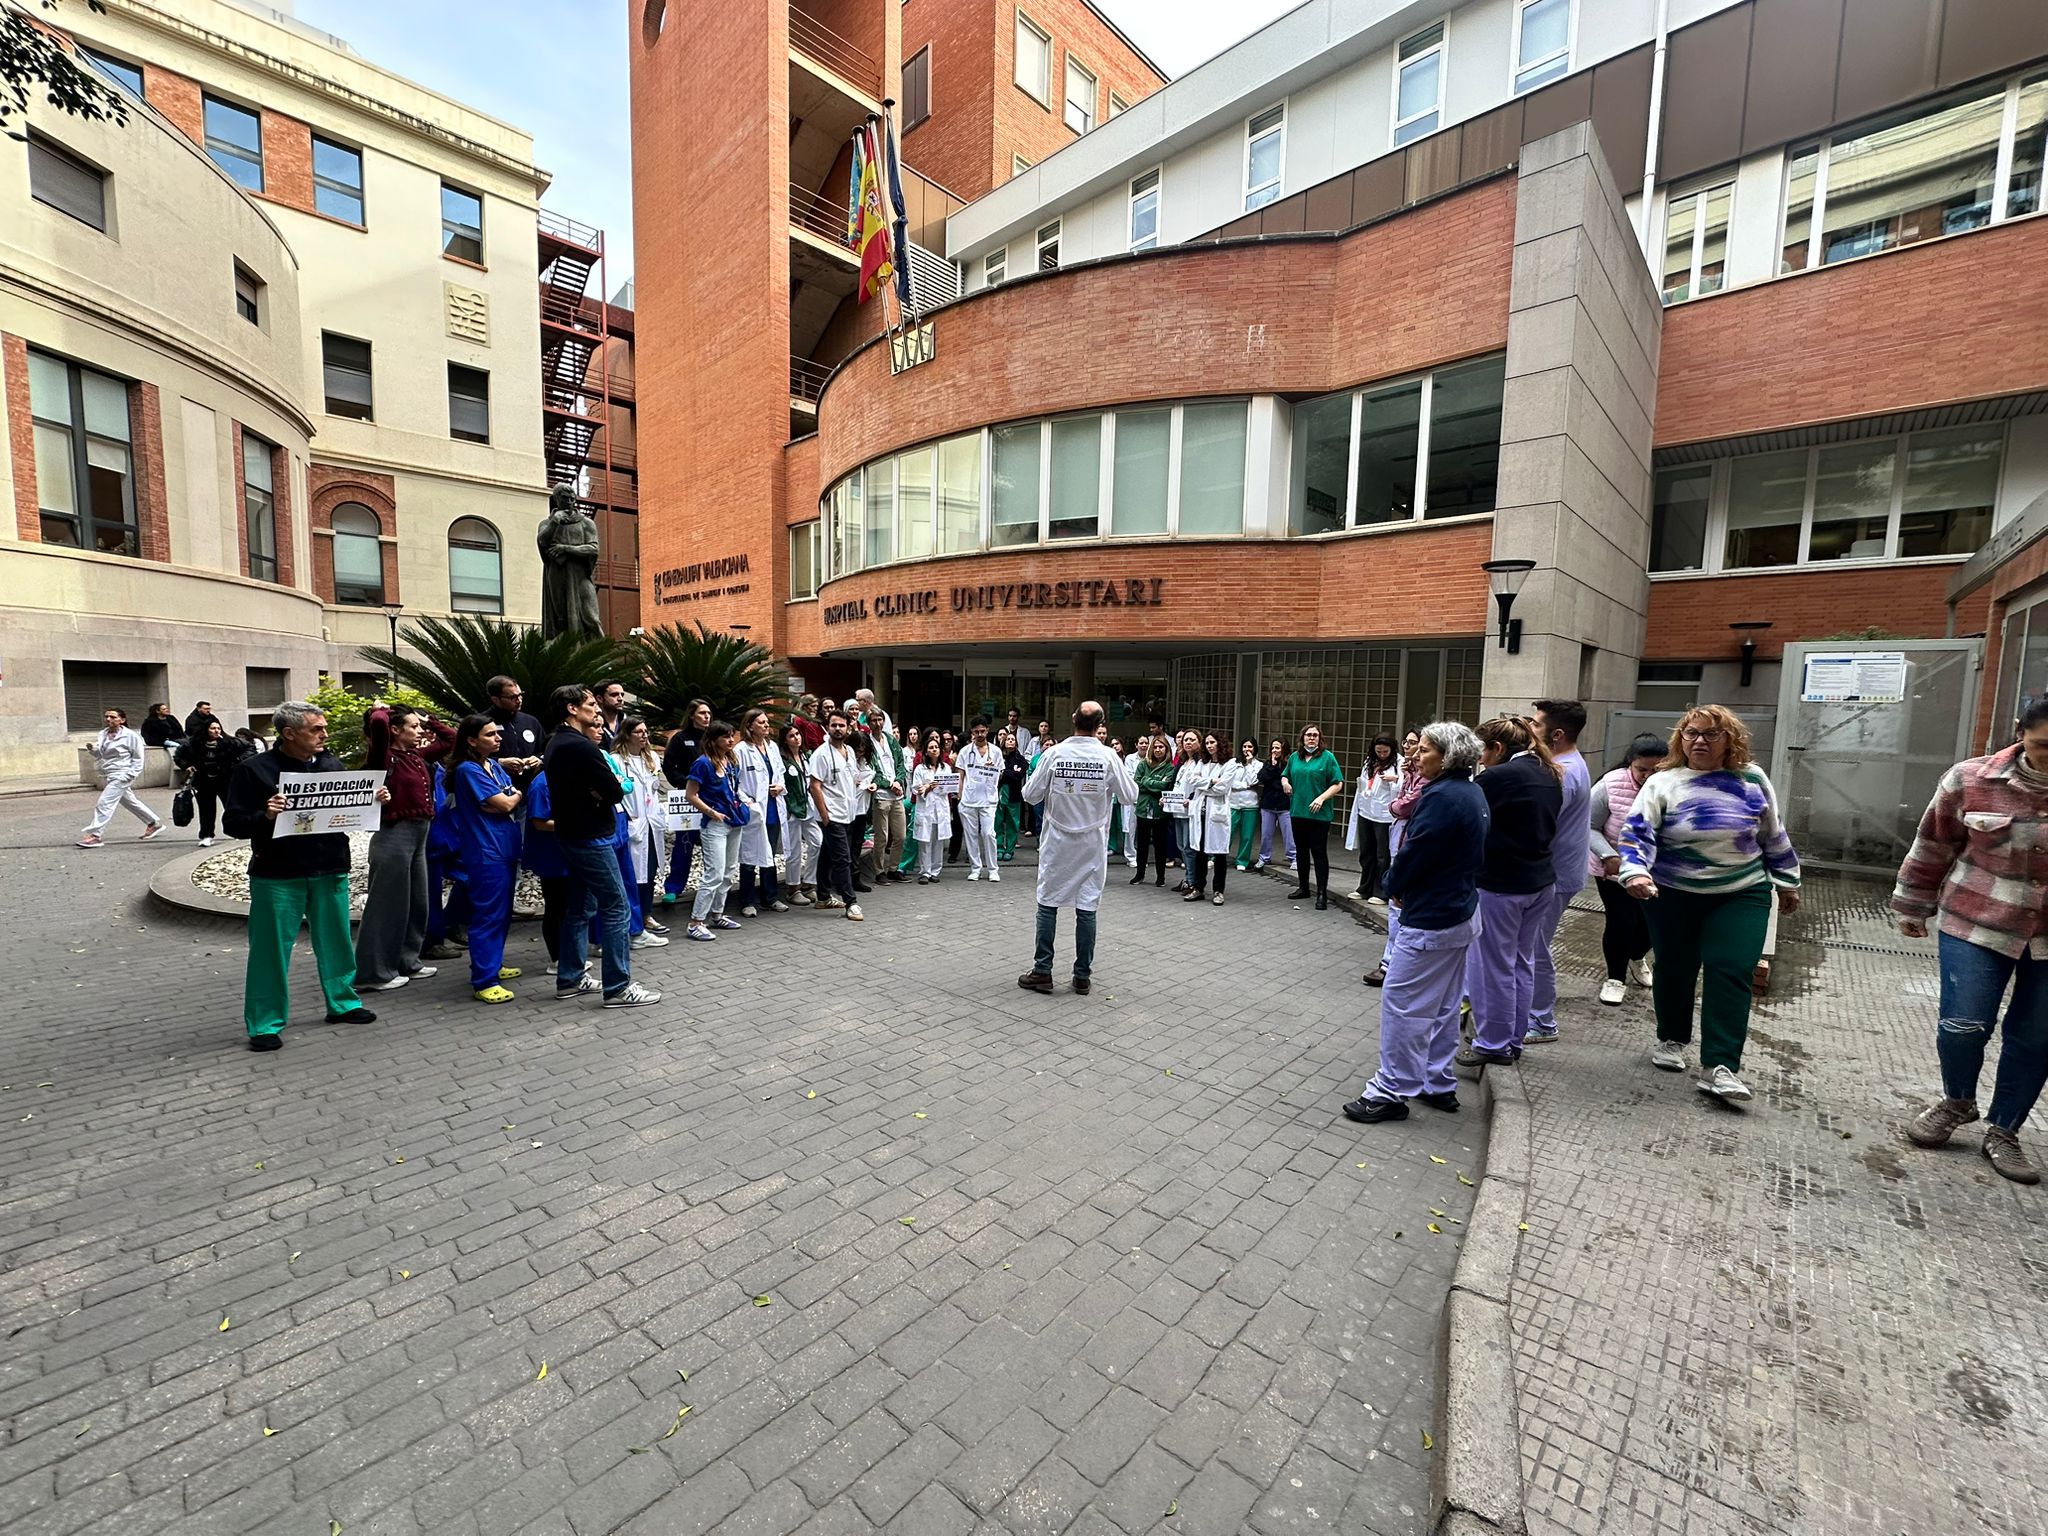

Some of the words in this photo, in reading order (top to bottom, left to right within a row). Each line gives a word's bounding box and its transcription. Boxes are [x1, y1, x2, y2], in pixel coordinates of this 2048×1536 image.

[662, 563, 701, 588] GENERALITAT
[702, 553, 750, 580] VALENCIANA
[823, 599, 868, 625] HOSPITAL
[950, 578, 1163, 611] UNIVERSITARI
[1055, 769, 1063, 777] ES
[283, 783, 300, 794] NO
[302, 782, 317, 793] ES
[319, 779, 374, 791] VOCACIÓN
[296, 792, 373, 809] EXPLOTACIÓN
[669, 805, 678, 813] ES
